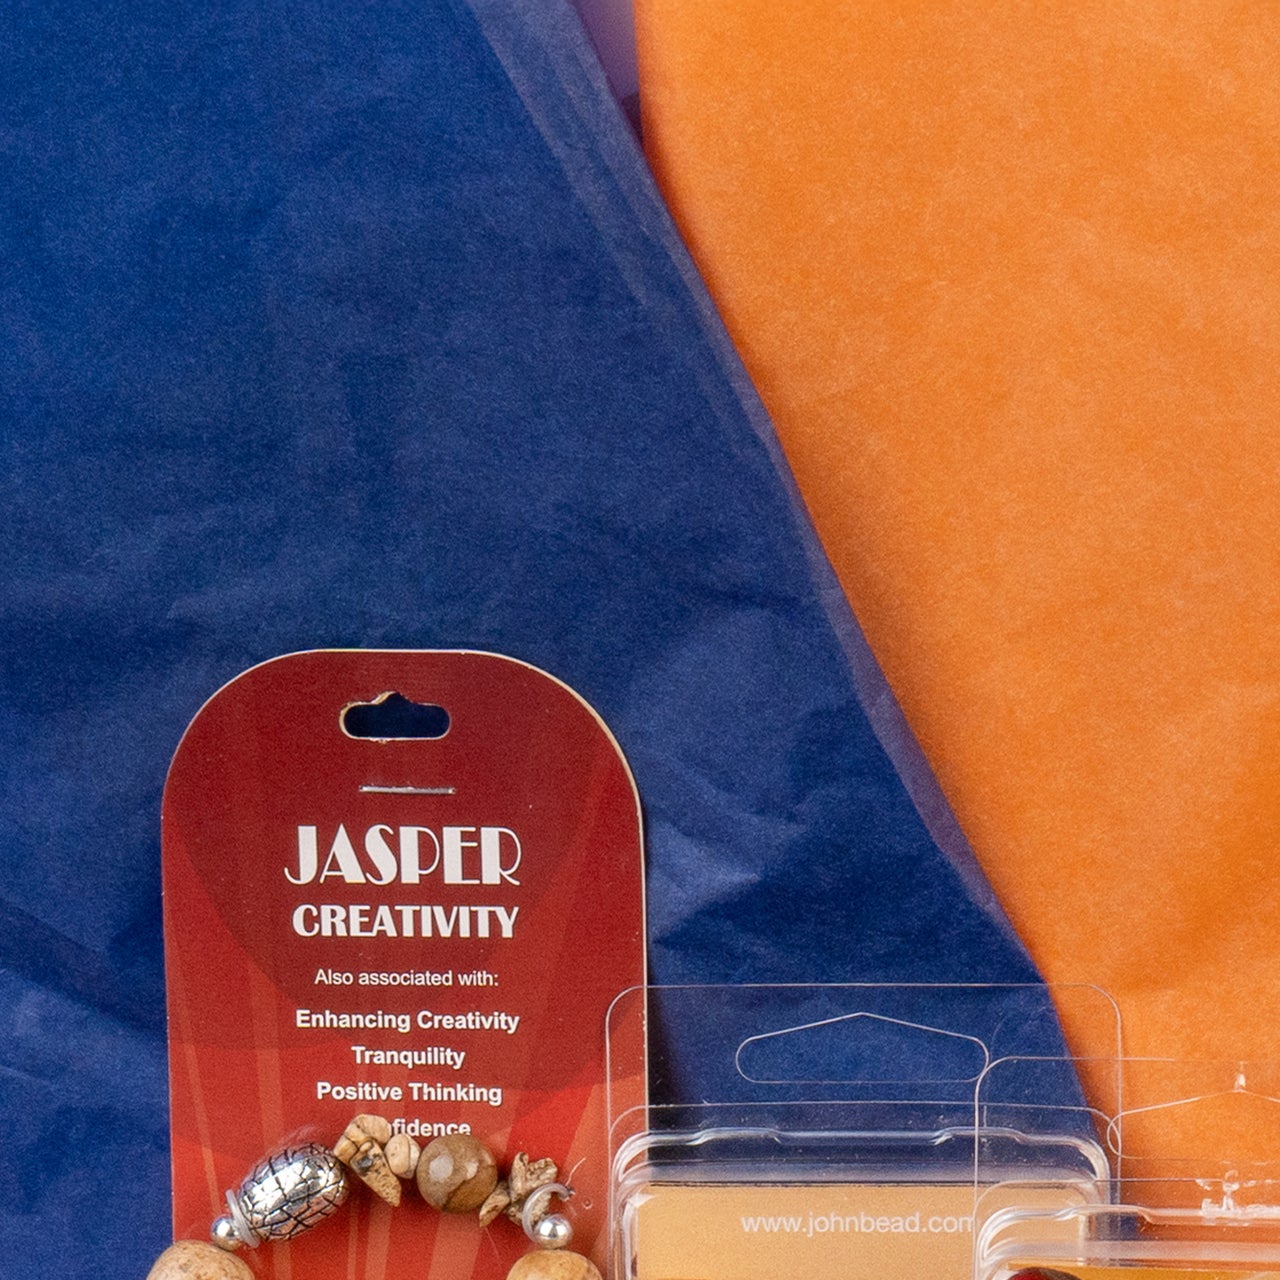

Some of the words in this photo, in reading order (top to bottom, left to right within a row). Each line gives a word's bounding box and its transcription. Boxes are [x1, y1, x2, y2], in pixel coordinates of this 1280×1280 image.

[284, 823, 521, 885] JASPER
[292, 904, 519, 938] CREATIVITY
[314, 969, 353, 985] Also
[358, 970, 453, 986] associated
[458, 971, 499, 986] with:
[296, 1010, 411, 1032] Enhancing
[416, 1011, 520, 1033] Creativity
[351, 1046, 465, 1069] Tranquility
[317, 1082, 402, 1100] Positive
[409, 1083, 502, 1105] Thinking
[391, 1118, 472, 1137] fidence
